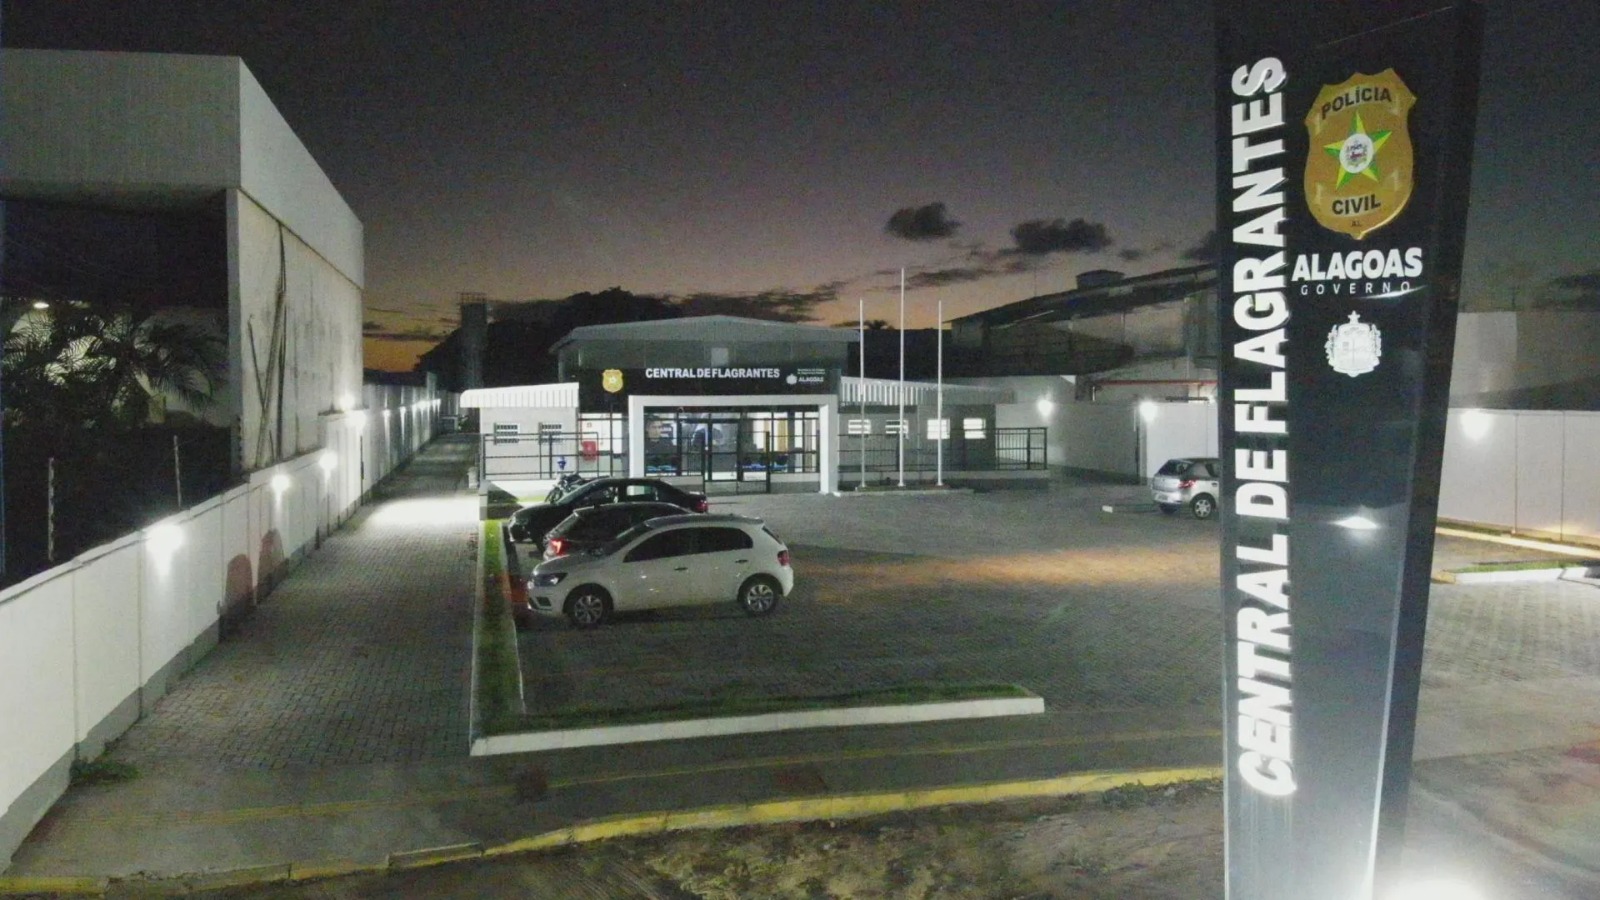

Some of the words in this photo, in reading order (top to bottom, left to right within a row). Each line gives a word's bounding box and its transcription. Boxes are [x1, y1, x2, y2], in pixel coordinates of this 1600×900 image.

[1321, 86, 1392, 121] POLÍCIA
[1331, 193, 1382, 215] CIVIL
[1231, 56, 1289, 434] FLAGRANTES
[1291, 247, 1423, 282] ALAGOAS
[1300, 281, 1411, 296] GOVERNO
[645, 367, 696, 378] CENTRAL
[696, 367, 711, 378] DE
[711, 367, 780, 378] FLAGRANTES
[1235, 448, 1289, 520] DE
[1236, 532, 1296, 796] CENTRAL
